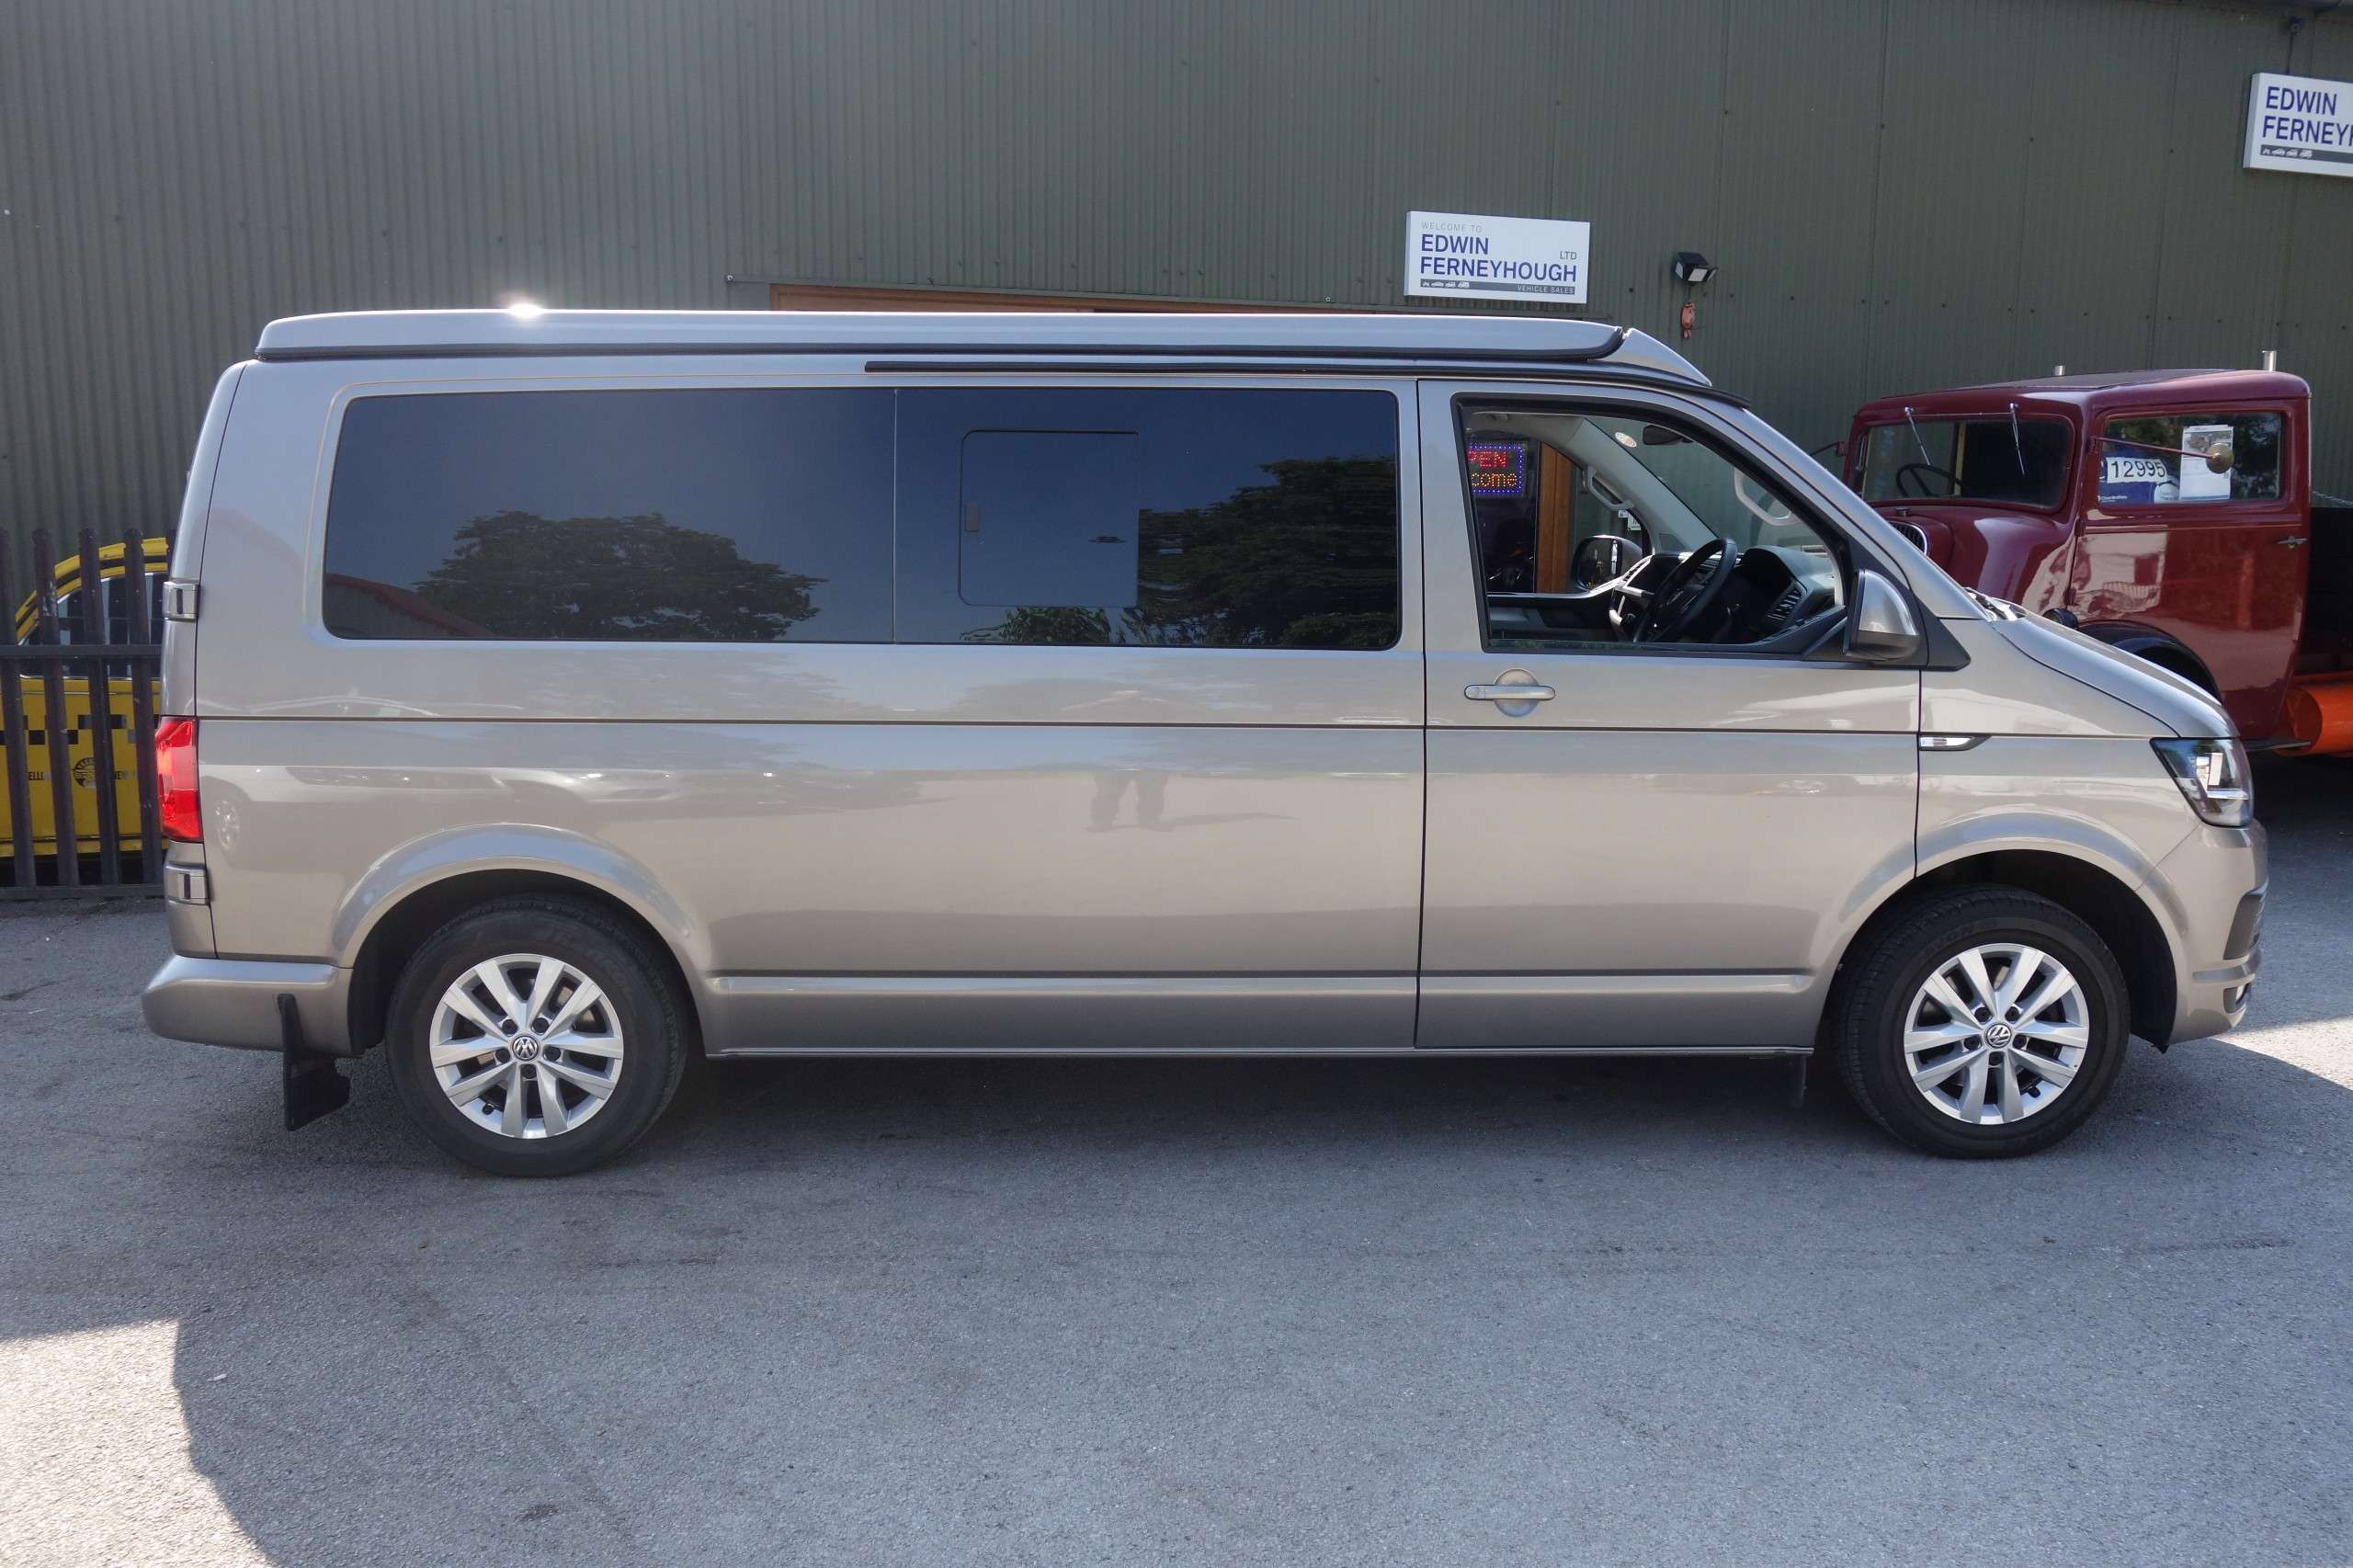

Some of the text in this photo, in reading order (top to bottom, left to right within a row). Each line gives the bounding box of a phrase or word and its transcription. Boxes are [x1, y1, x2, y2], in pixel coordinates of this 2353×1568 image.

[2265, 85, 2337, 116] EDWIN
[1421, 221, 1483, 233] WELCOME TO
[1421, 233, 1489, 255] EDWIN
[1559, 250, 1577, 260] LTD
[1420, 256, 1576, 282] FERNEYHOUGH
[1517, 284, 1574, 294] VEHICLE SALES
[2110, 460, 2166, 478] 12995
